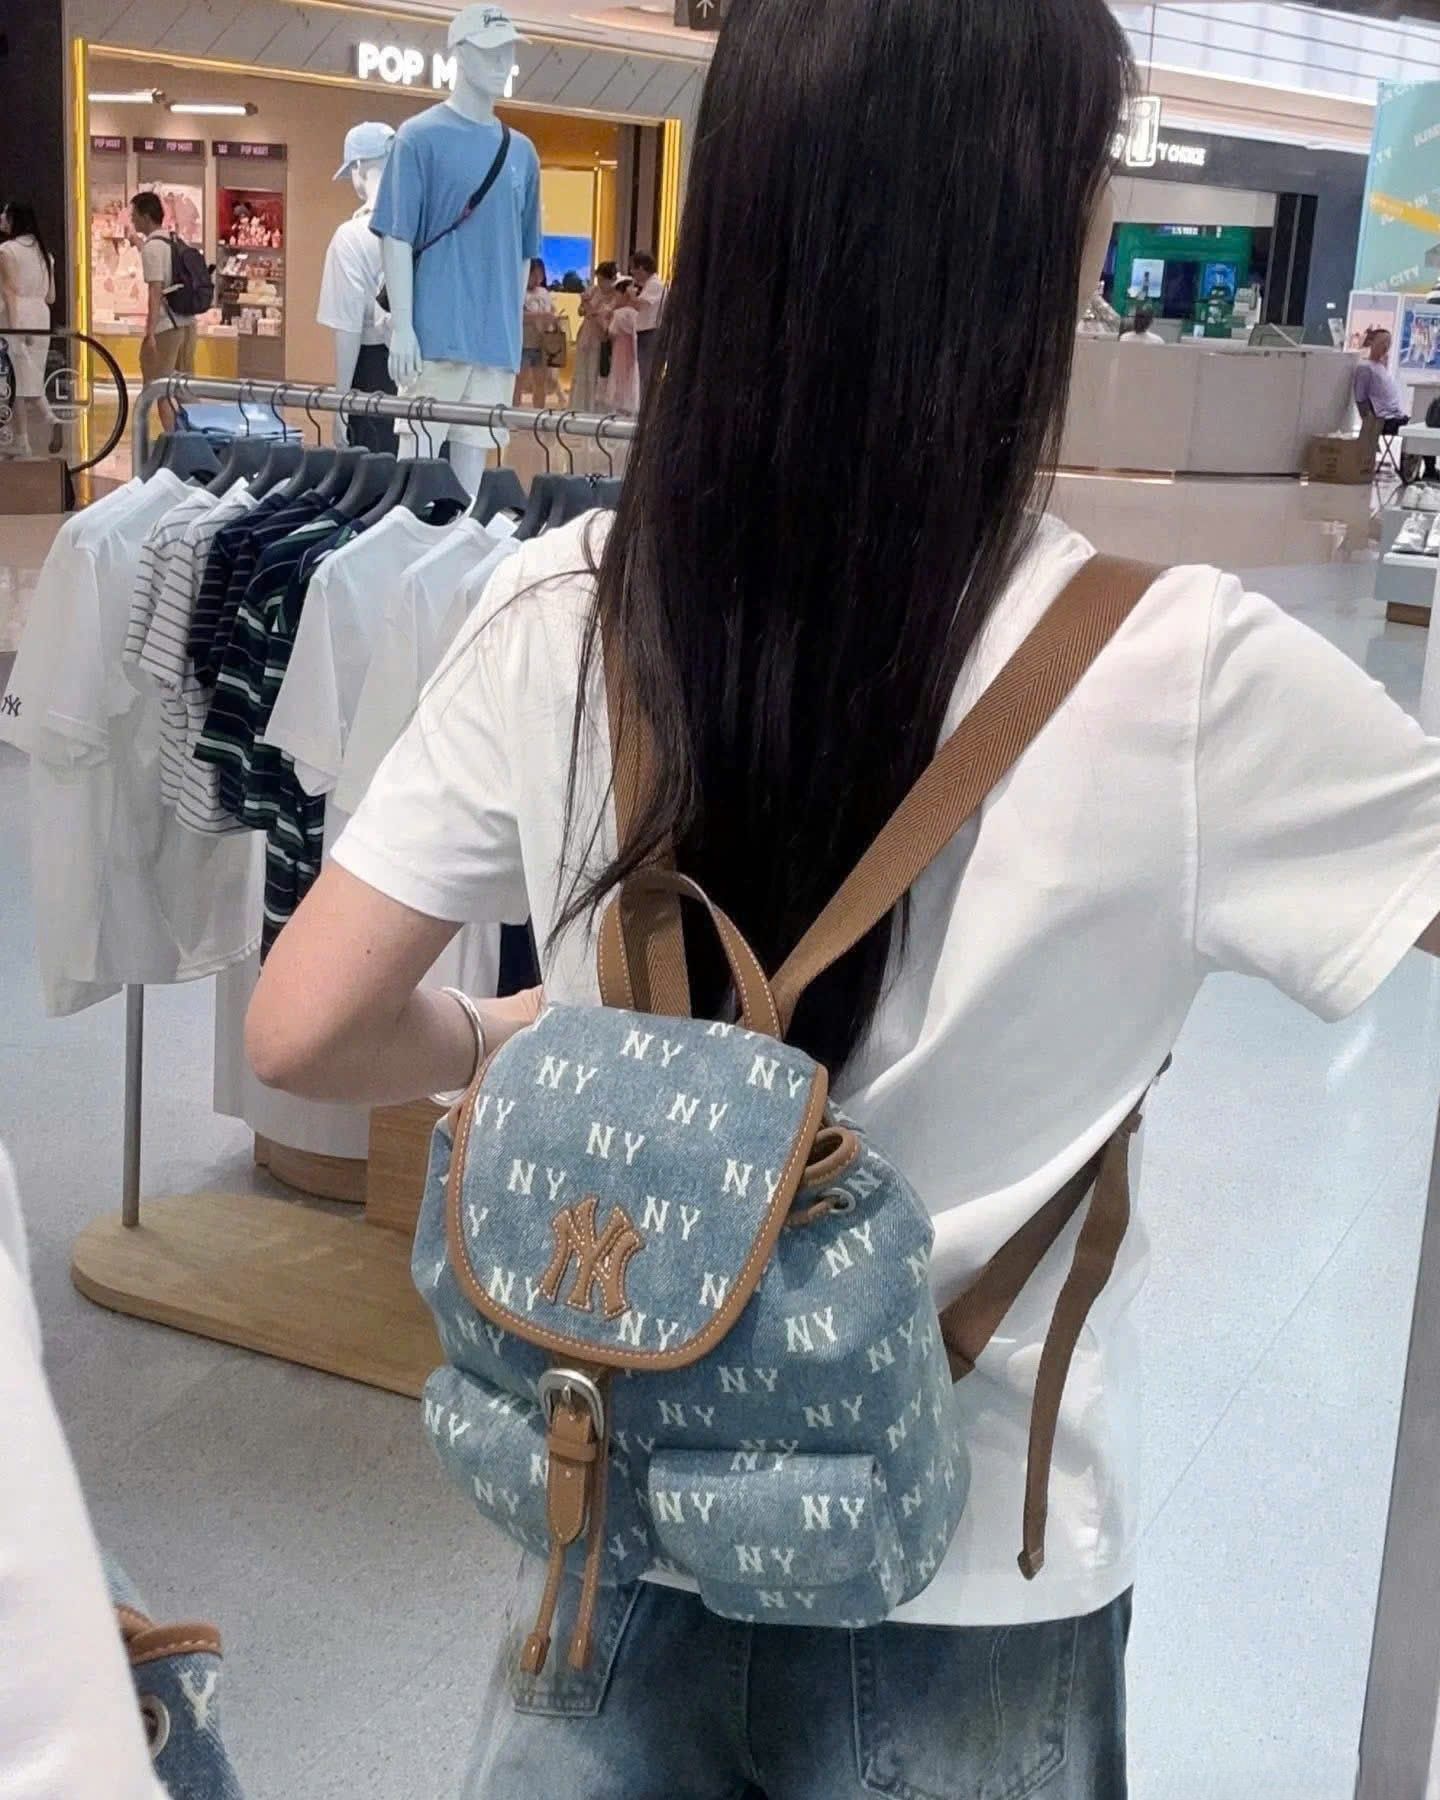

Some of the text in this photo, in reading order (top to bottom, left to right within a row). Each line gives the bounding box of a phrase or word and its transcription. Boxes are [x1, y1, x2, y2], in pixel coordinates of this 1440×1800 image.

[358, 41, 424, 85] POP
[620, 1029, 684, 1068] NY
[536, 1055, 599, 1095] NY
[746, 1055, 805, 1099] NY
[667, 1092, 729, 1131] NY
[585, 1121, 646, 1166] NY
[507, 1159, 567, 1201] NY
[721, 1158, 783, 1204] NY
[640, 1196, 701, 1241] NY
[821, 1219, 876, 1279] NY
[487, 1266, 541, 1312] NY
[616, 1310, 679, 1352] NY
[784, 1306, 838, 1356] NY
[866, 1314, 916, 1375] NY
[718, 1366, 779, 1394] NY
[657, 1399, 715, 1428] NY
[801, 1395, 863, 1428] NY
[656, 1491, 717, 1524] NY
[801, 1495, 865, 1531] NY
[734, 1545, 795, 1576] NY
[756, 1591, 816, 1609] NY
